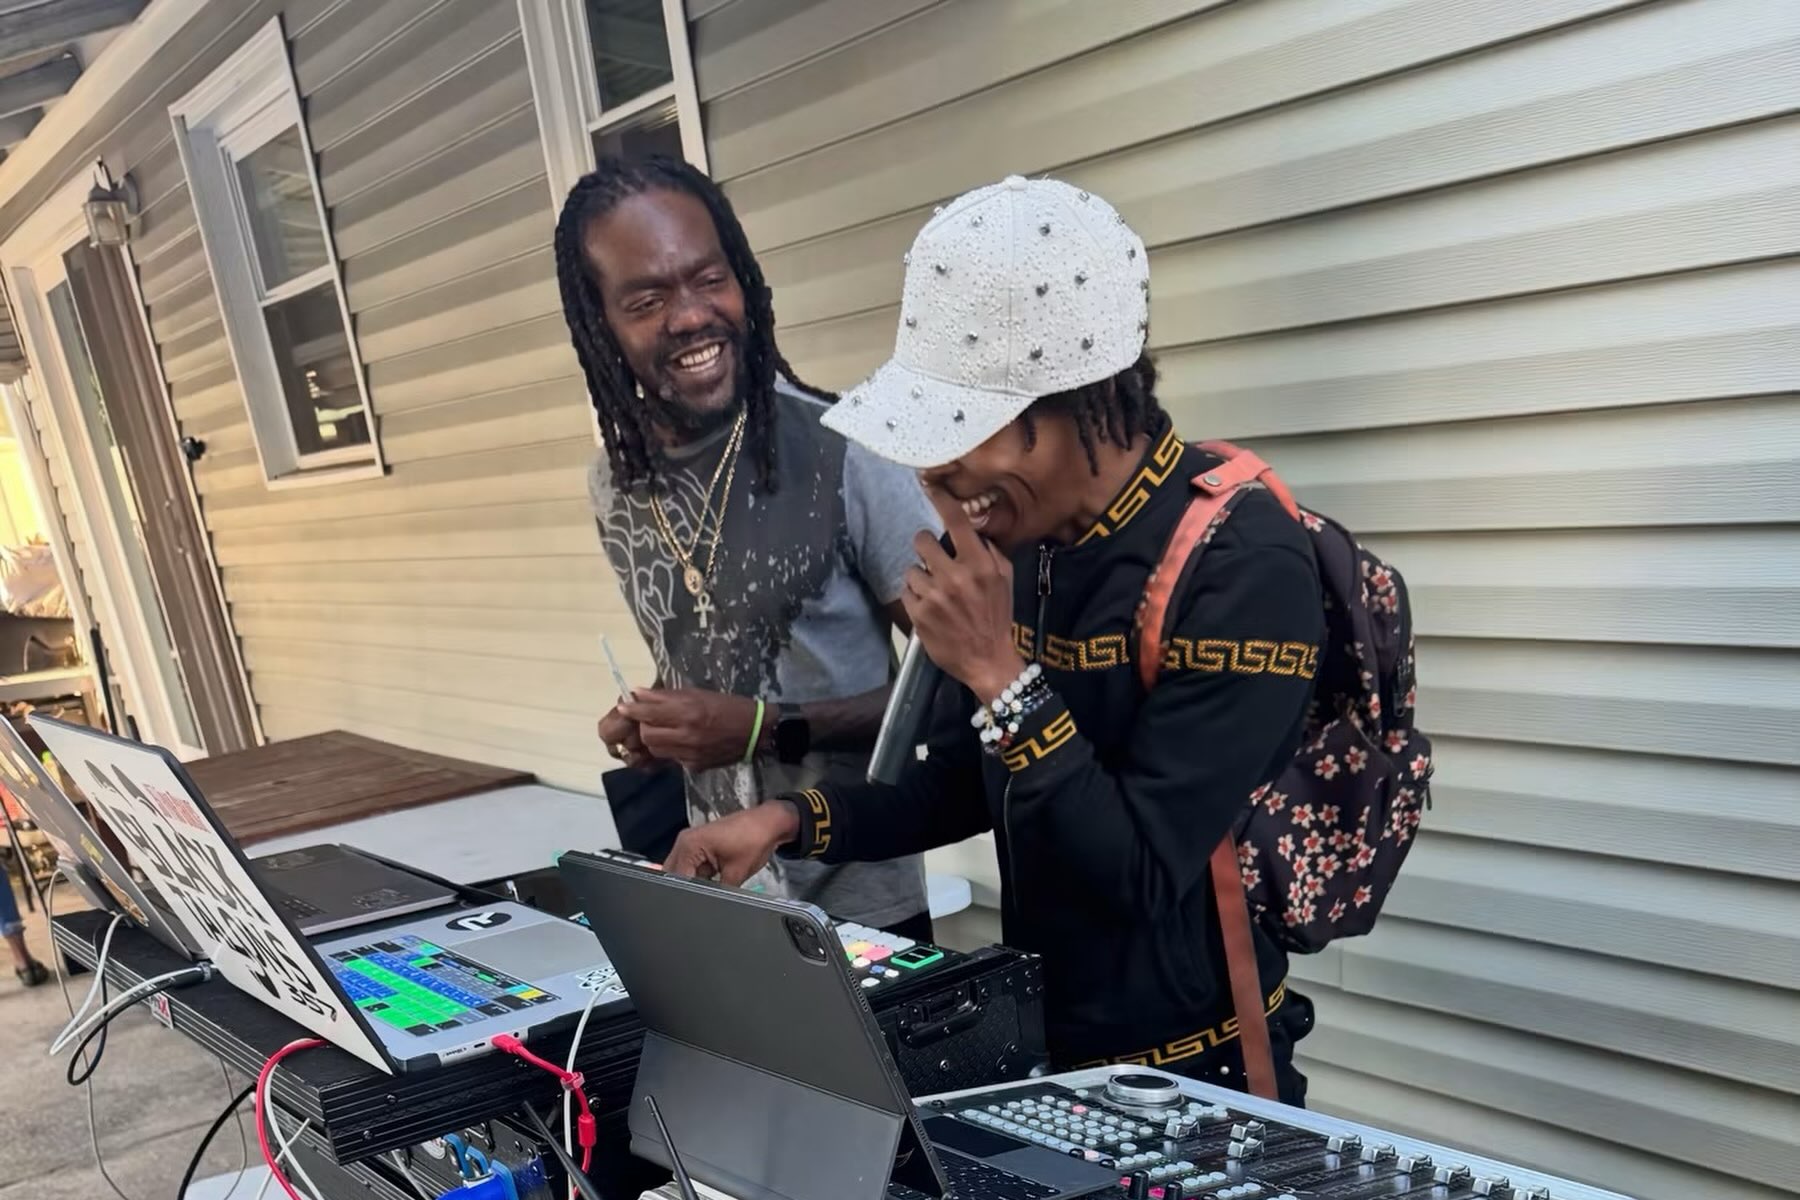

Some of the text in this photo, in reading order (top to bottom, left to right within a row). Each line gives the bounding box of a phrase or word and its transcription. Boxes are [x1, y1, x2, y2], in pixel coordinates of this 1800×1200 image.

[110, 805, 270, 925] BLACK
[163, 881, 316, 996] TALONS
[282, 979, 337, 1022] 357
